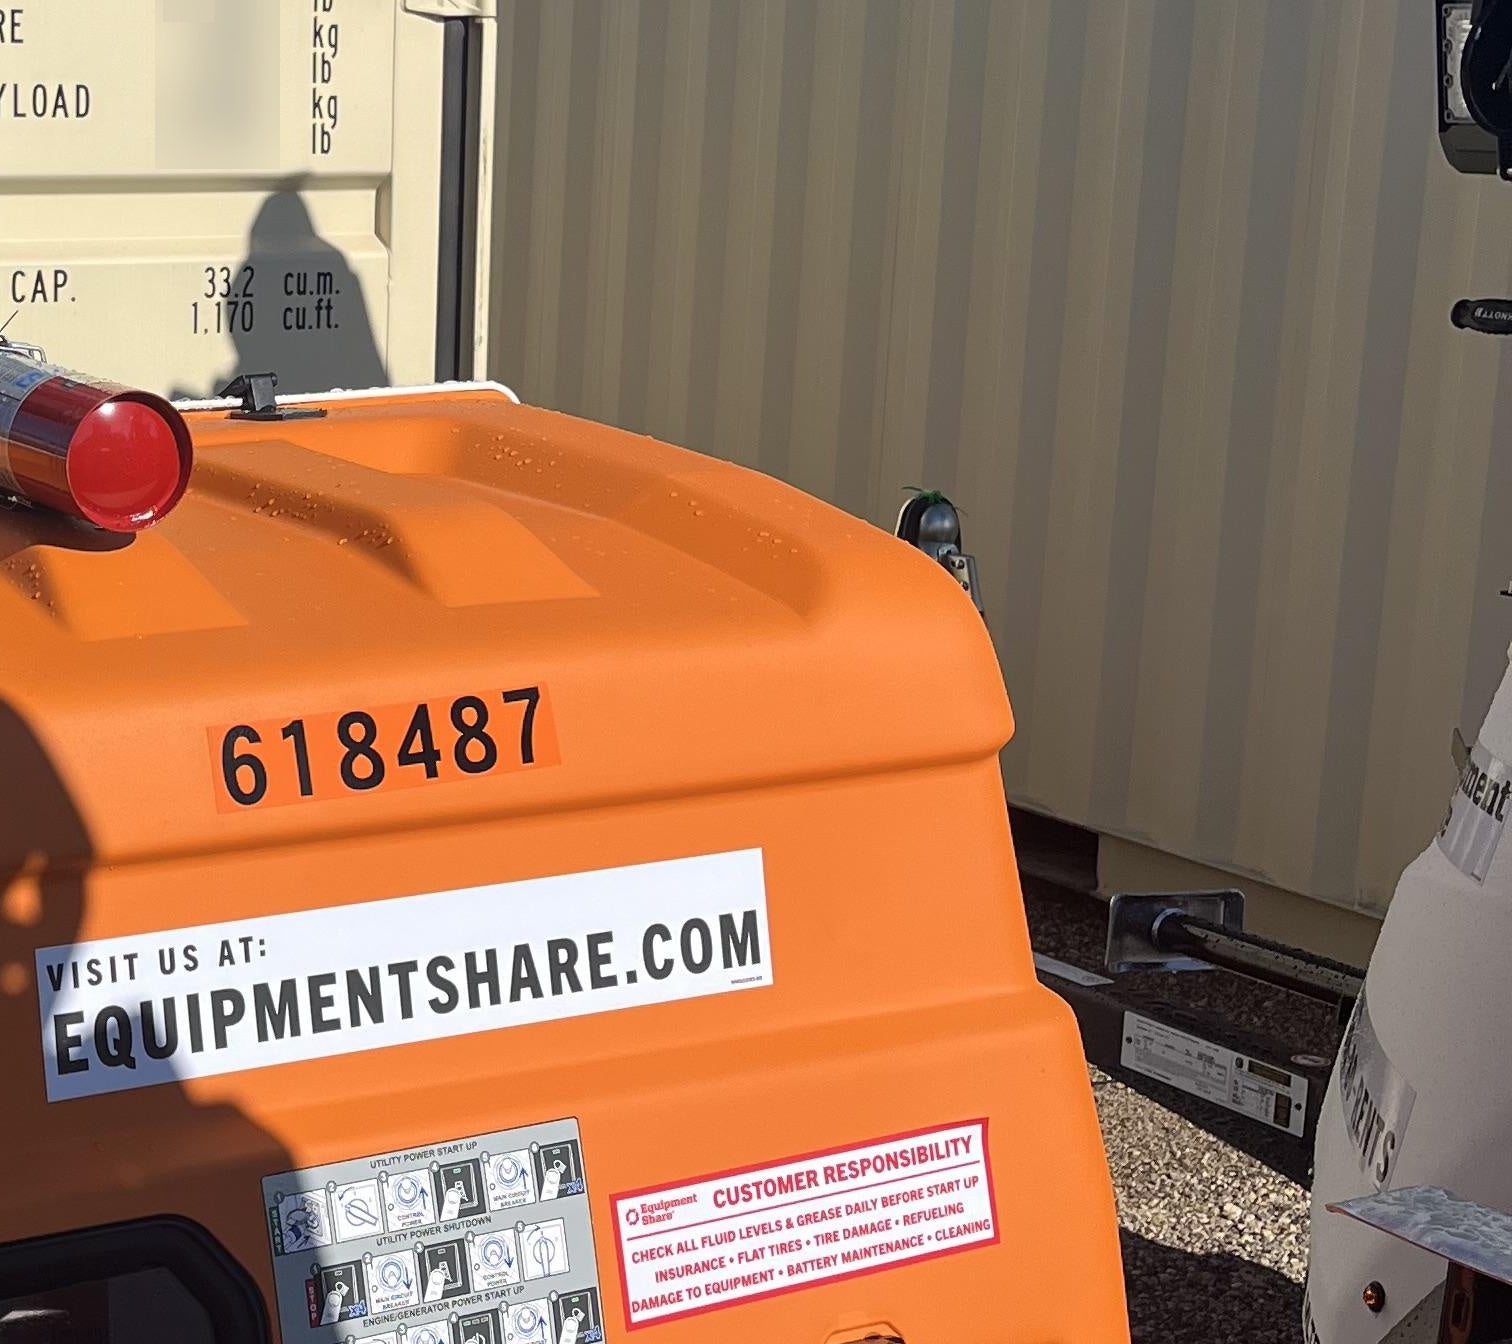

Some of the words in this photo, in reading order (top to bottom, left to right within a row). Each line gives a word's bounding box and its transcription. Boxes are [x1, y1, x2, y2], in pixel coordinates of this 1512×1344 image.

[312, 17, 340, 58] kg
[312, 52, 334, 85] lb
[312, 89, 339, 131] kg
[312, 123, 334, 156] lb
[12, 269, 77, 304] CAP.
[203, 266, 257, 300] 33.2
[283, 267, 342, 297] cu.m.
[190, 301, 256, 335] 1,170
[282, 301, 341, 333] cu.ft.
[219, 684, 545, 807] 618487
[46, 954, 139, 993] VISIT
[159, 943, 200, 974] US
[218, 936, 269, 968] AT:
[50, 908, 764, 1075] EQUIPMENTSHARE.COM
[370, 1155, 402, 1169] UTILITY
[403, 1150, 435, 1164] POWER
[437, 1145, 464, 1157] START
[466, 1141, 477, 1151] UP
[713, 1168, 819, 1209] CUSTOMER
[823, 1134, 973, 1185] RESPONSIBILITY
[631, 1245, 674, 1265] CHECK
[676, 1239, 698, 1256] ALL
[701, 1231, 736, 1250] FLUID
[738, 1220, 783, 1242] LEVELS
[785, 1215, 795, 1230] &
[796, 1207, 843, 1227] GREASE
[844, 1198, 878, 1218] DAILY
[881, 1189, 924, 1210] BEFORE
[926, 1180, 961, 1200] START
[963, 1175, 979, 1190] UP
[640, 1192, 698, 1214] Equipment
[376, 1233, 407, 1247] UTILITY
[409, 1226, 441, 1241] POWER
[443, 1216, 492, 1233] SHUTDOWN
[655, 1256, 727, 1283] INSURANCE
[737, 1246, 767, 1265] FLAT
[768, 1237, 803, 1258] TIRES
[813, 1229, 840, 1248] TIRE
[842, 1219, 892, 1242] DAMAGE
[902, 1201, 965, 1227] REFUELING
[631, 1288, 684, 1314] DAMAGE
[685, 1284, 702, 1300] TO
[704, 1268, 776, 1297] EQUIPMENT
[786, 1254, 838, 1278] BATTERY
[841, 1233, 926, 1266] MAINTENANCE
[934, 1218, 991, 1244] CLEANING
[363, 1301, 449, 1328] ENGINE/GENERATOR
[451, 1295, 482, 1308] POWER
[484, 1289, 511, 1301] START
[513, 1285, 525, 1295] UP
